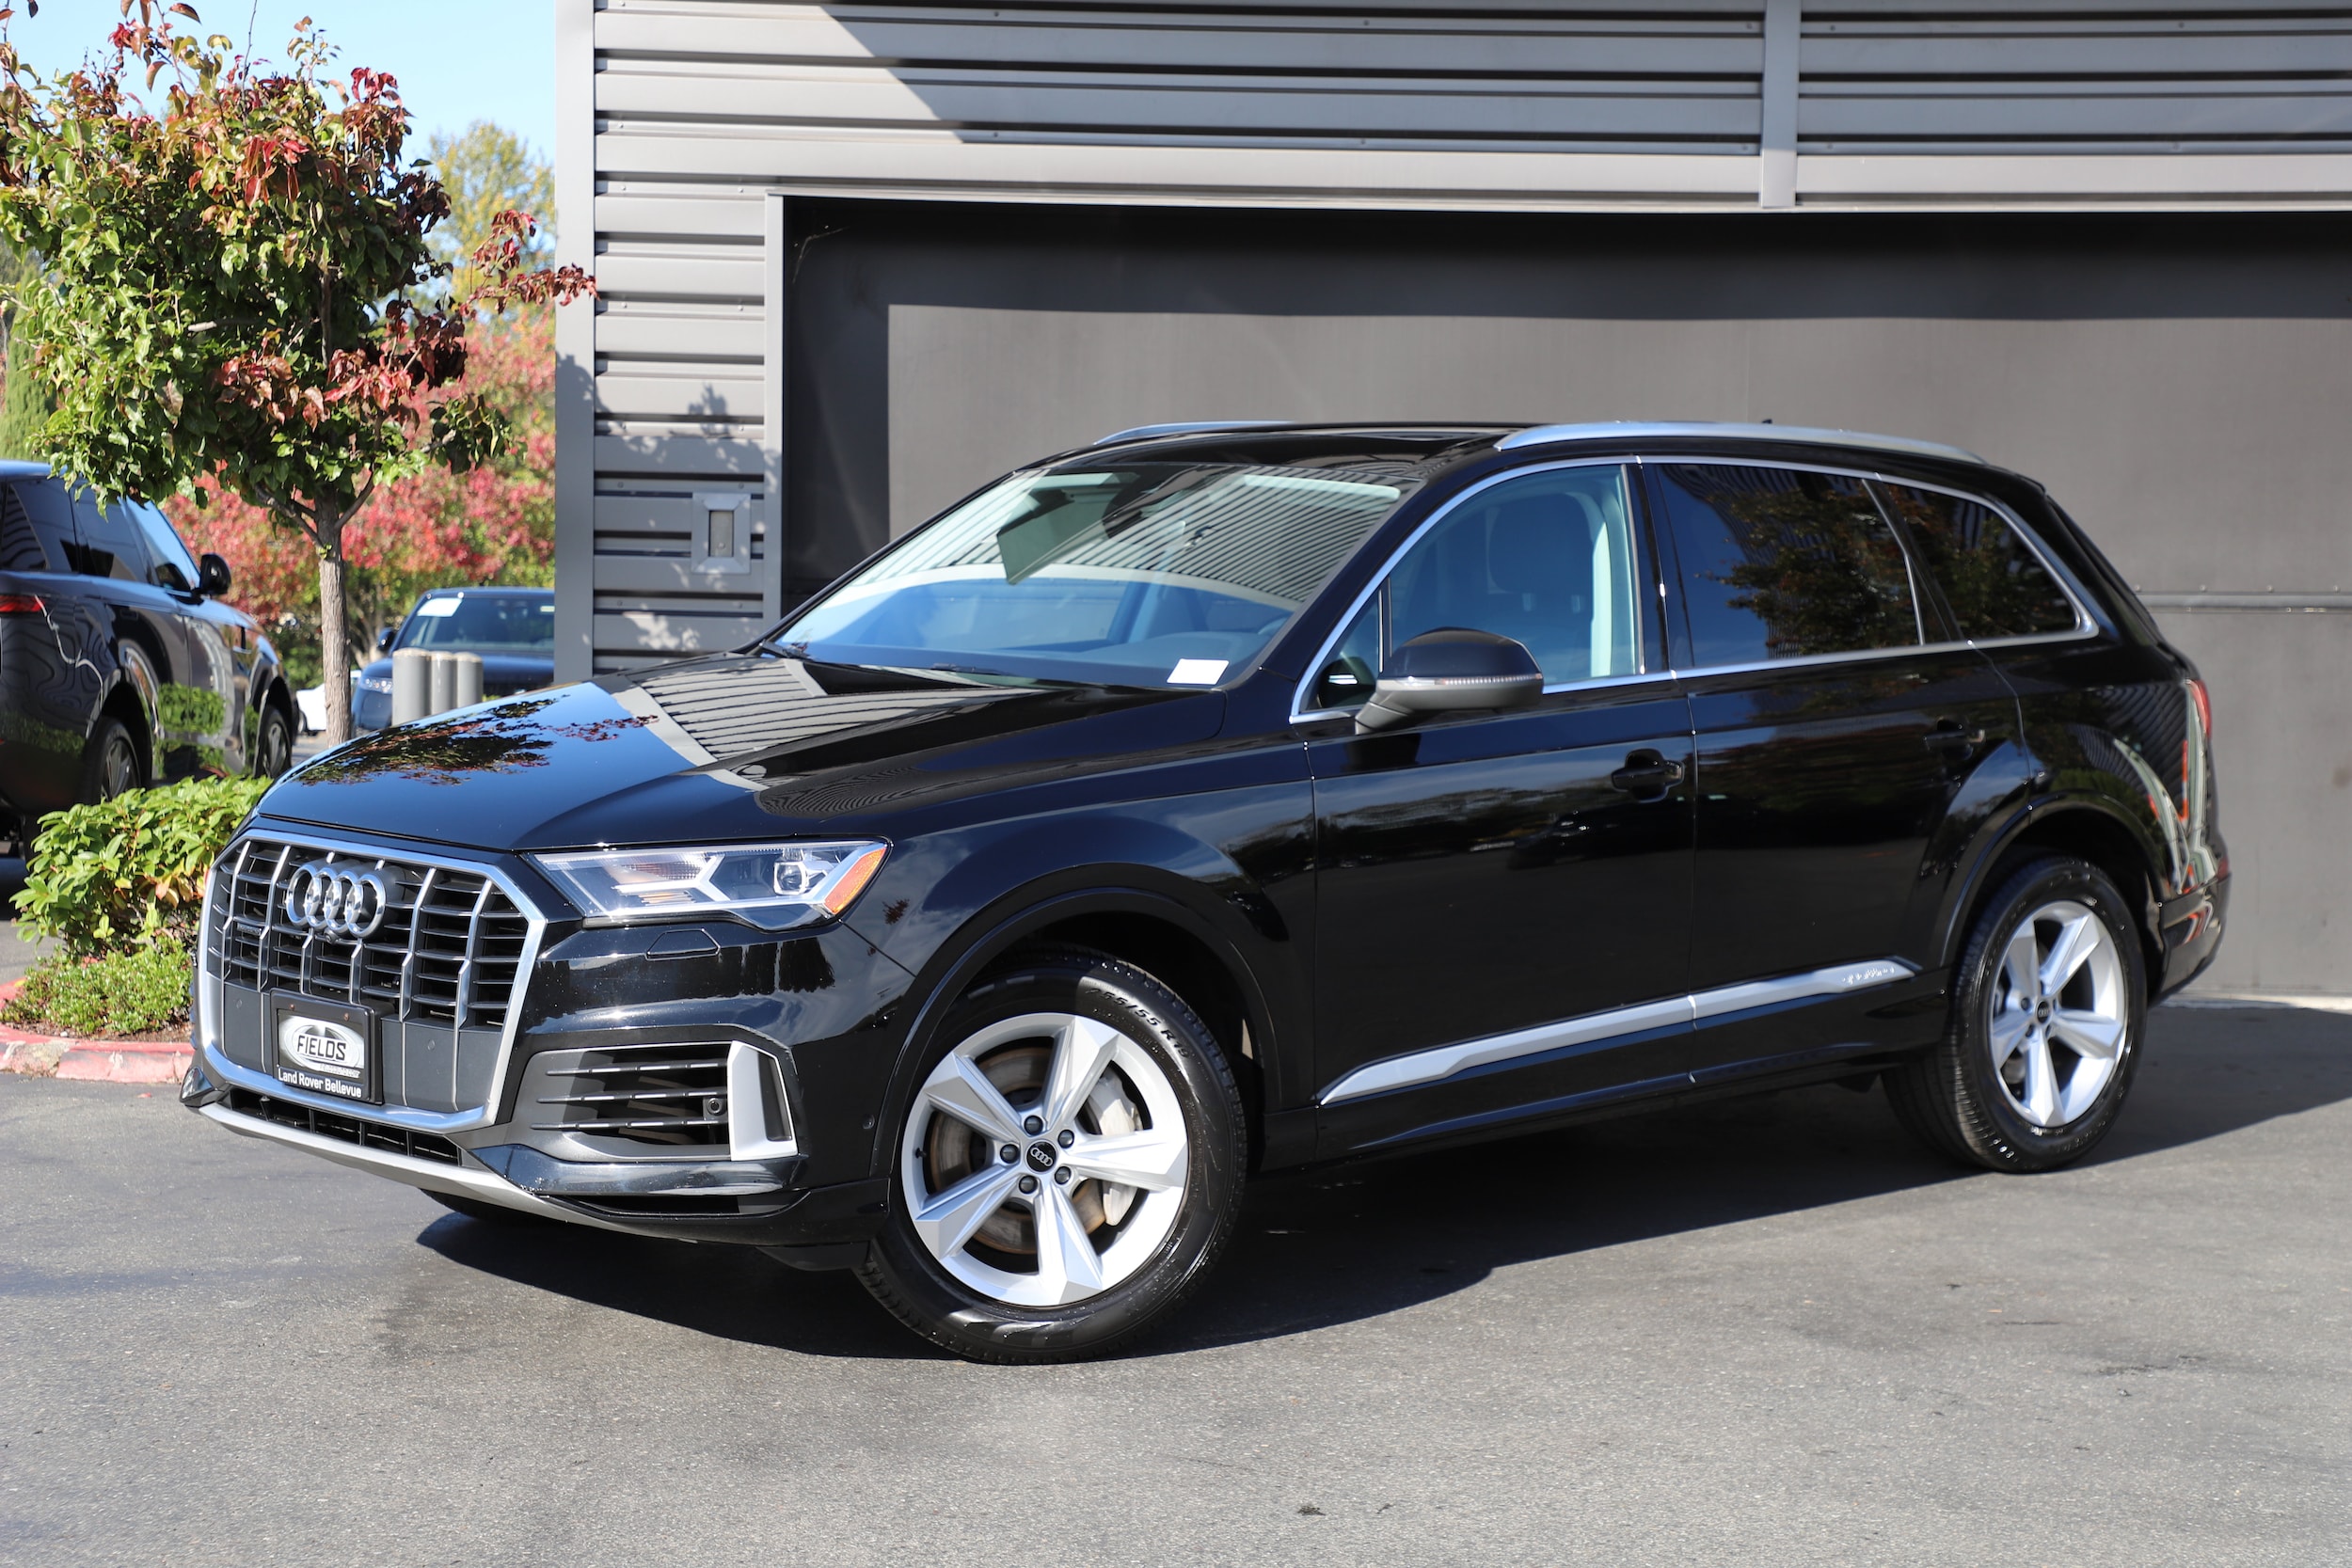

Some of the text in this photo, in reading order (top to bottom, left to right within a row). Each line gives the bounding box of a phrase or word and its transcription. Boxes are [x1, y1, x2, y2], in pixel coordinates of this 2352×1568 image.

[296, 1035, 347, 1061] FIELDS
[278, 1068, 362, 1099] Land Rover Bellevue
